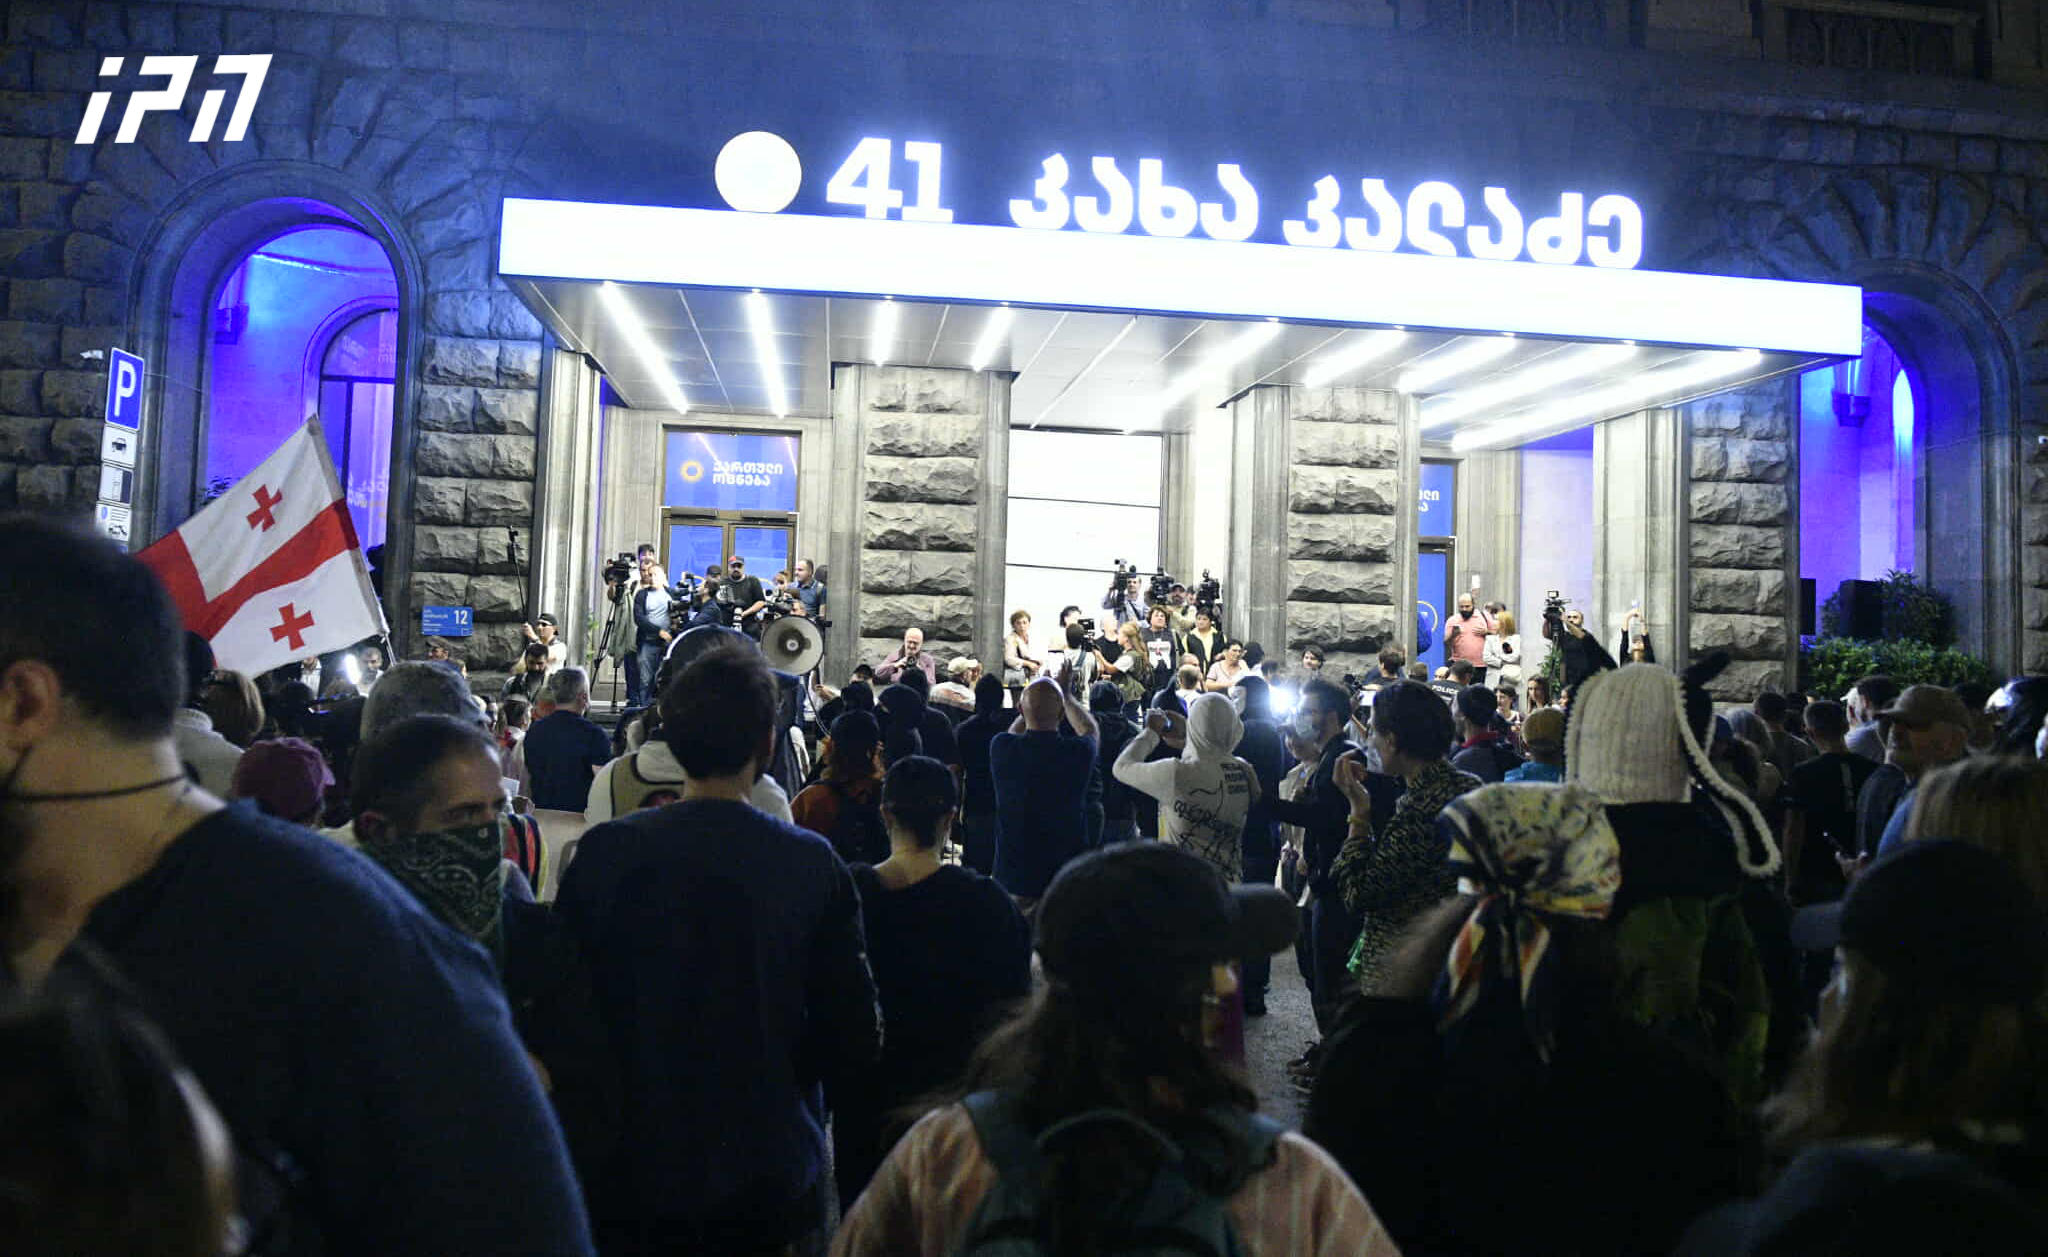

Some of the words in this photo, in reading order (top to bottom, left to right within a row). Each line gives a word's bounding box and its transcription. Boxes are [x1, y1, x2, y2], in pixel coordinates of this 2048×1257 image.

[826, 136, 954, 223] 41
[1009, 153, 1259, 241] კახა
[1282, 174, 1643, 270] კალაძე
[114, 360, 137, 417] P
[454, 609, 468, 625] 12
